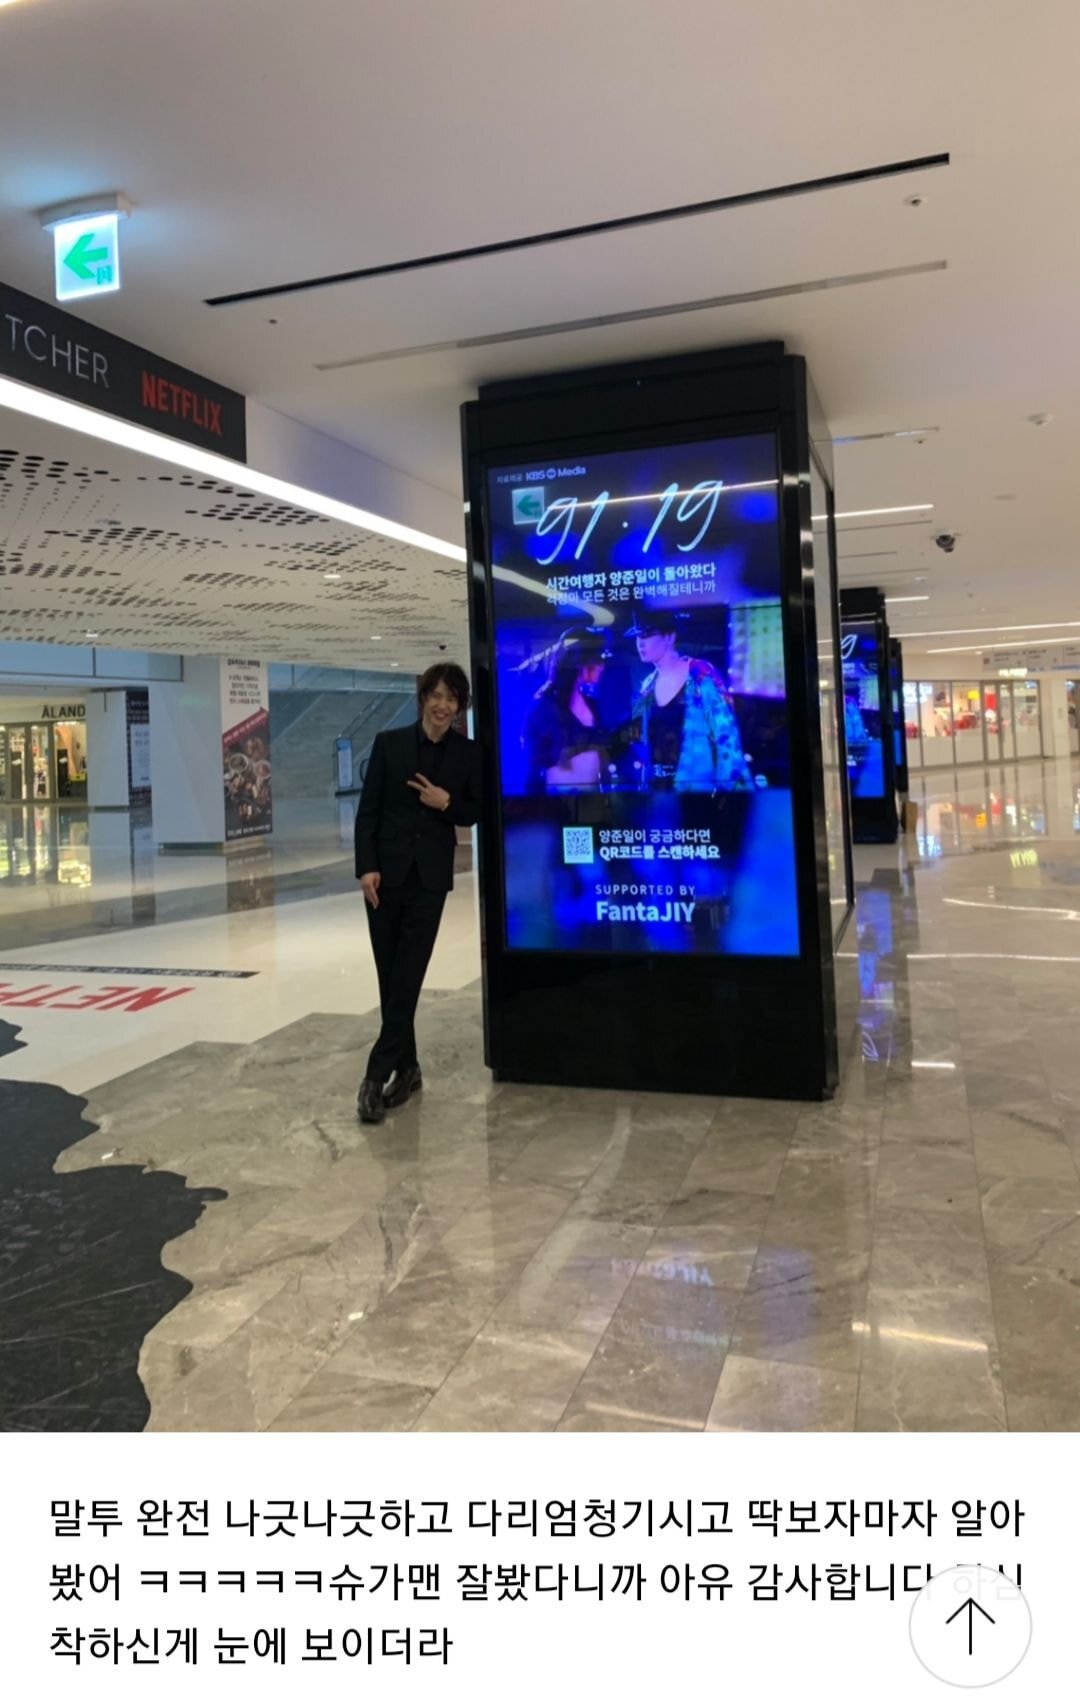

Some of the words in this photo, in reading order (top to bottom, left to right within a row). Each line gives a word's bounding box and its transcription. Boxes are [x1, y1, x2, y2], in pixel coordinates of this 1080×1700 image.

[5, 313, 110, 389] TCHER
[141, 370, 223, 437] NETFLIX
[525, 470, 546, 481] KBS
[557, 466, 586, 478] Media
[546, 573, 607, 592] 시간여행자
[609, 567, 660, 587] 양준일이
[664, 562, 717, 583] 돌아왔다
[582, 589, 605, 603] 모든
[608, 586, 631, 602] 것은
[633, 579, 717, 600] 완벽해질테니까
[599, 828, 647, 844] 양준일이
[649, 828, 711, 844] 궁금하다면
[599, 845, 655, 861] QR코드를
[657, 844, 721, 860] 스캔하세요
[595, 884, 674, 896] SUPPORTED
[679, 885, 696, 896] BY
[596, 901, 696, 922] FantaJIY
